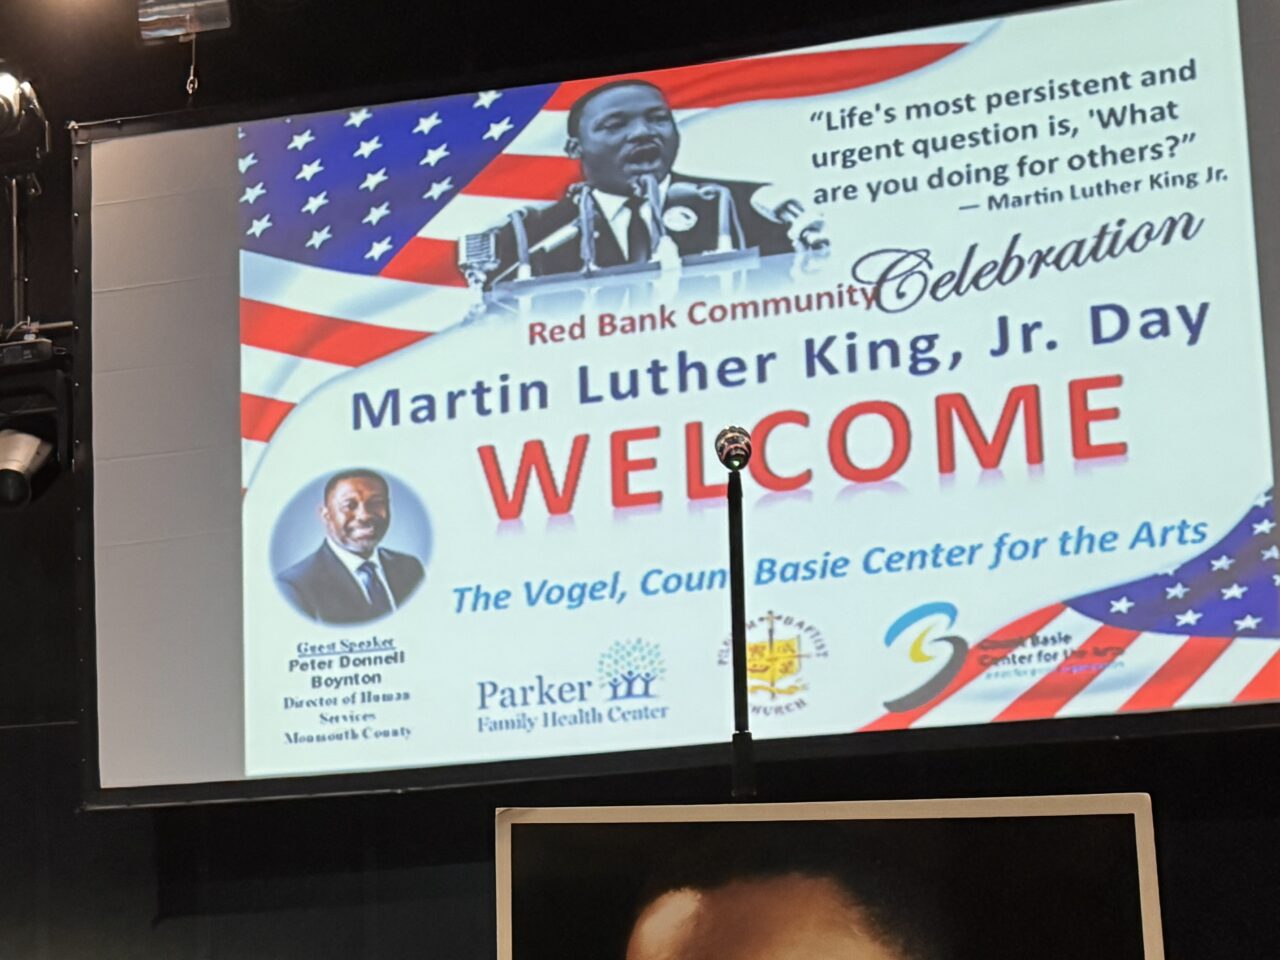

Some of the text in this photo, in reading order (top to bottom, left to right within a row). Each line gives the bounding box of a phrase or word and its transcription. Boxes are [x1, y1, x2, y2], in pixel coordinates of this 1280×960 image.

[905, 94, 976, 120] most
[986, 71, 1132, 114] persistent
[1140, 58, 1198, 86] and
[811, 140, 905, 171] urgent
[911, 119, 1038, 160] question
[1048, 115, 1079, 138] is,
[813, 182, 859, 205] are
[866, 172, 919, 201] you
[926, 160, 1010, 190] doing
[1017, 153, 1059, 178] for
[987, 187, 1064, 212] Martin
[1069, 176, 1141, 203] Luther
[1149, 169, 1200, 193] King
[1205, 164, 1229, 184] Jr.
[852, 211, 1206, 314] Celebration
[527, 282, 882, 345] Red Bank Community
[351, 301, 1211, 432] Martin Luther King, Jr. Day
[477, 373, 1128, 521] WELCOME
[453, 518, 1209, 614] The Vogel, Coun Basie Center for the Arts
[289, 651, 405, 672] Peter Donnell
[311, 673, 382, 689] Boynton
[342, 692, 357, 705] of
[477, 674, 593, 711] Parker
[745, 697, 808, 716] HURCH
[478, 705, 670, 733] Family Health Center
